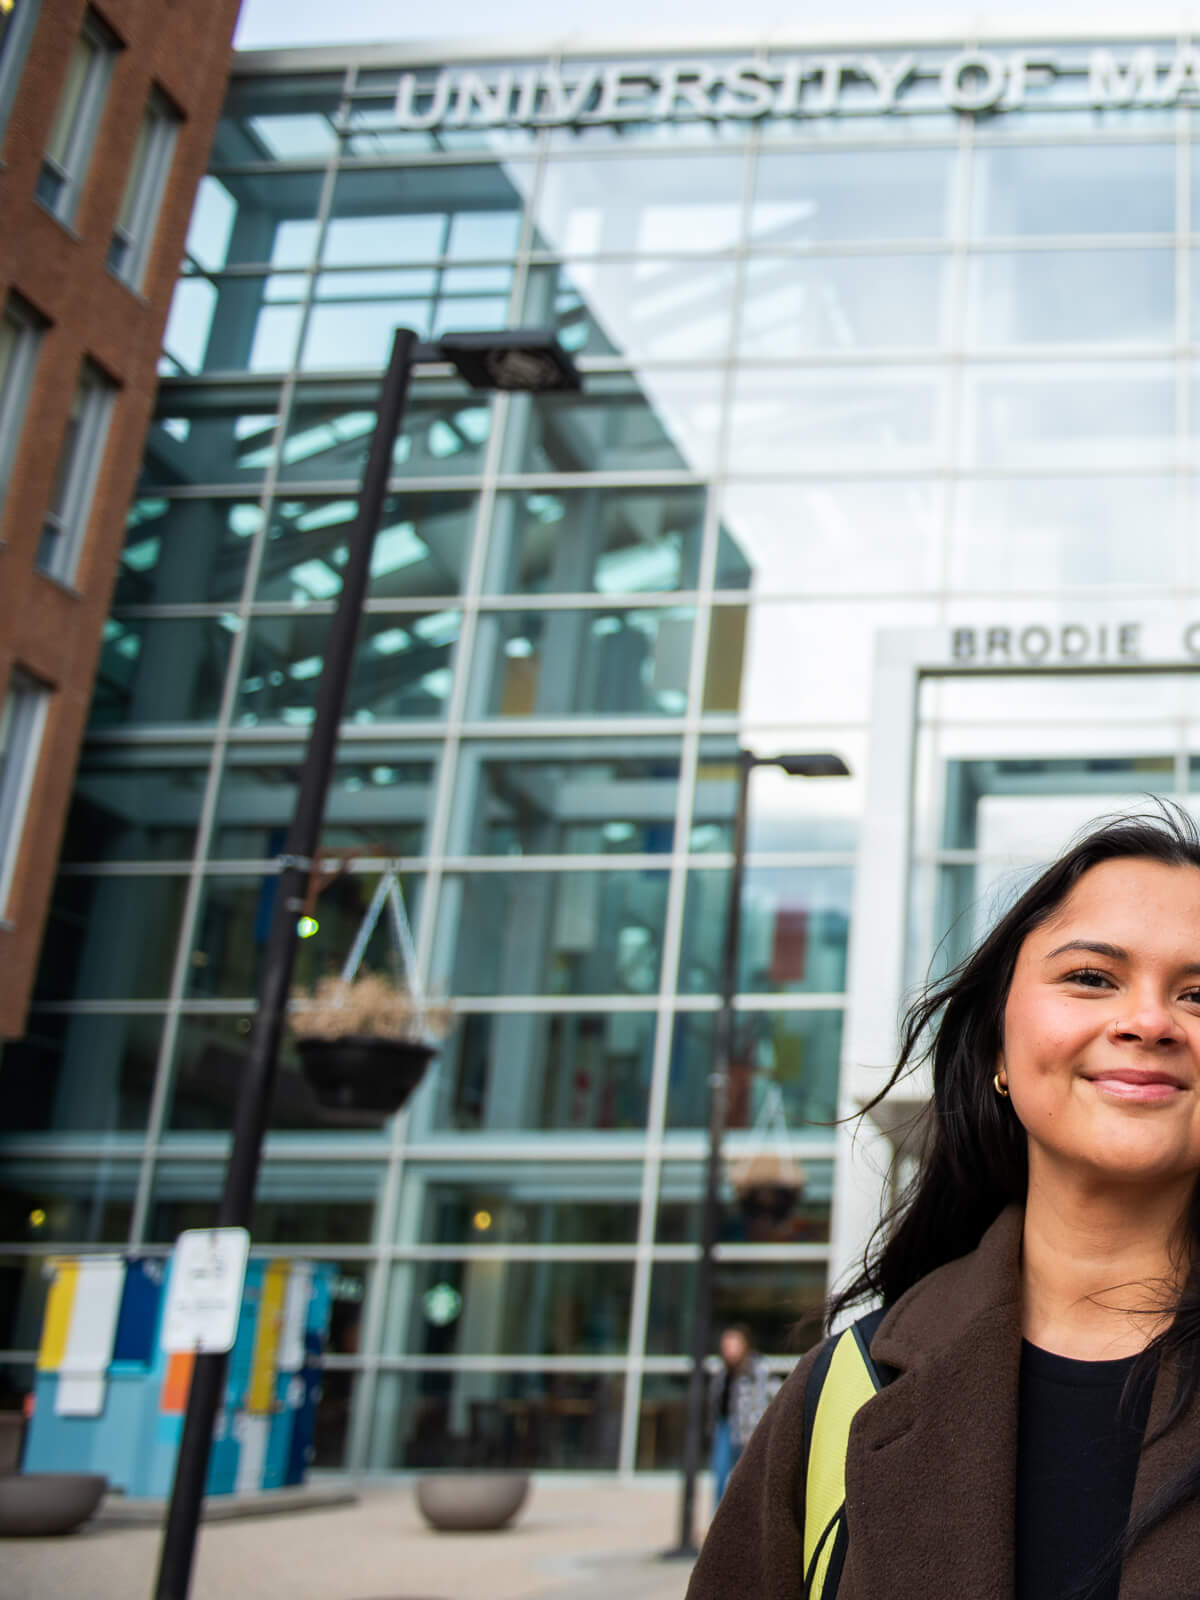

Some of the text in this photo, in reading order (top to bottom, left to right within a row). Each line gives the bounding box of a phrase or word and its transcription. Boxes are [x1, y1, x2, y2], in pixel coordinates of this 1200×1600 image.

[396, 56, 915, 128] UNIVERSITY
[940, 48, 1059, 112] OF
[952, 622, 1143, 661] BRODIE
